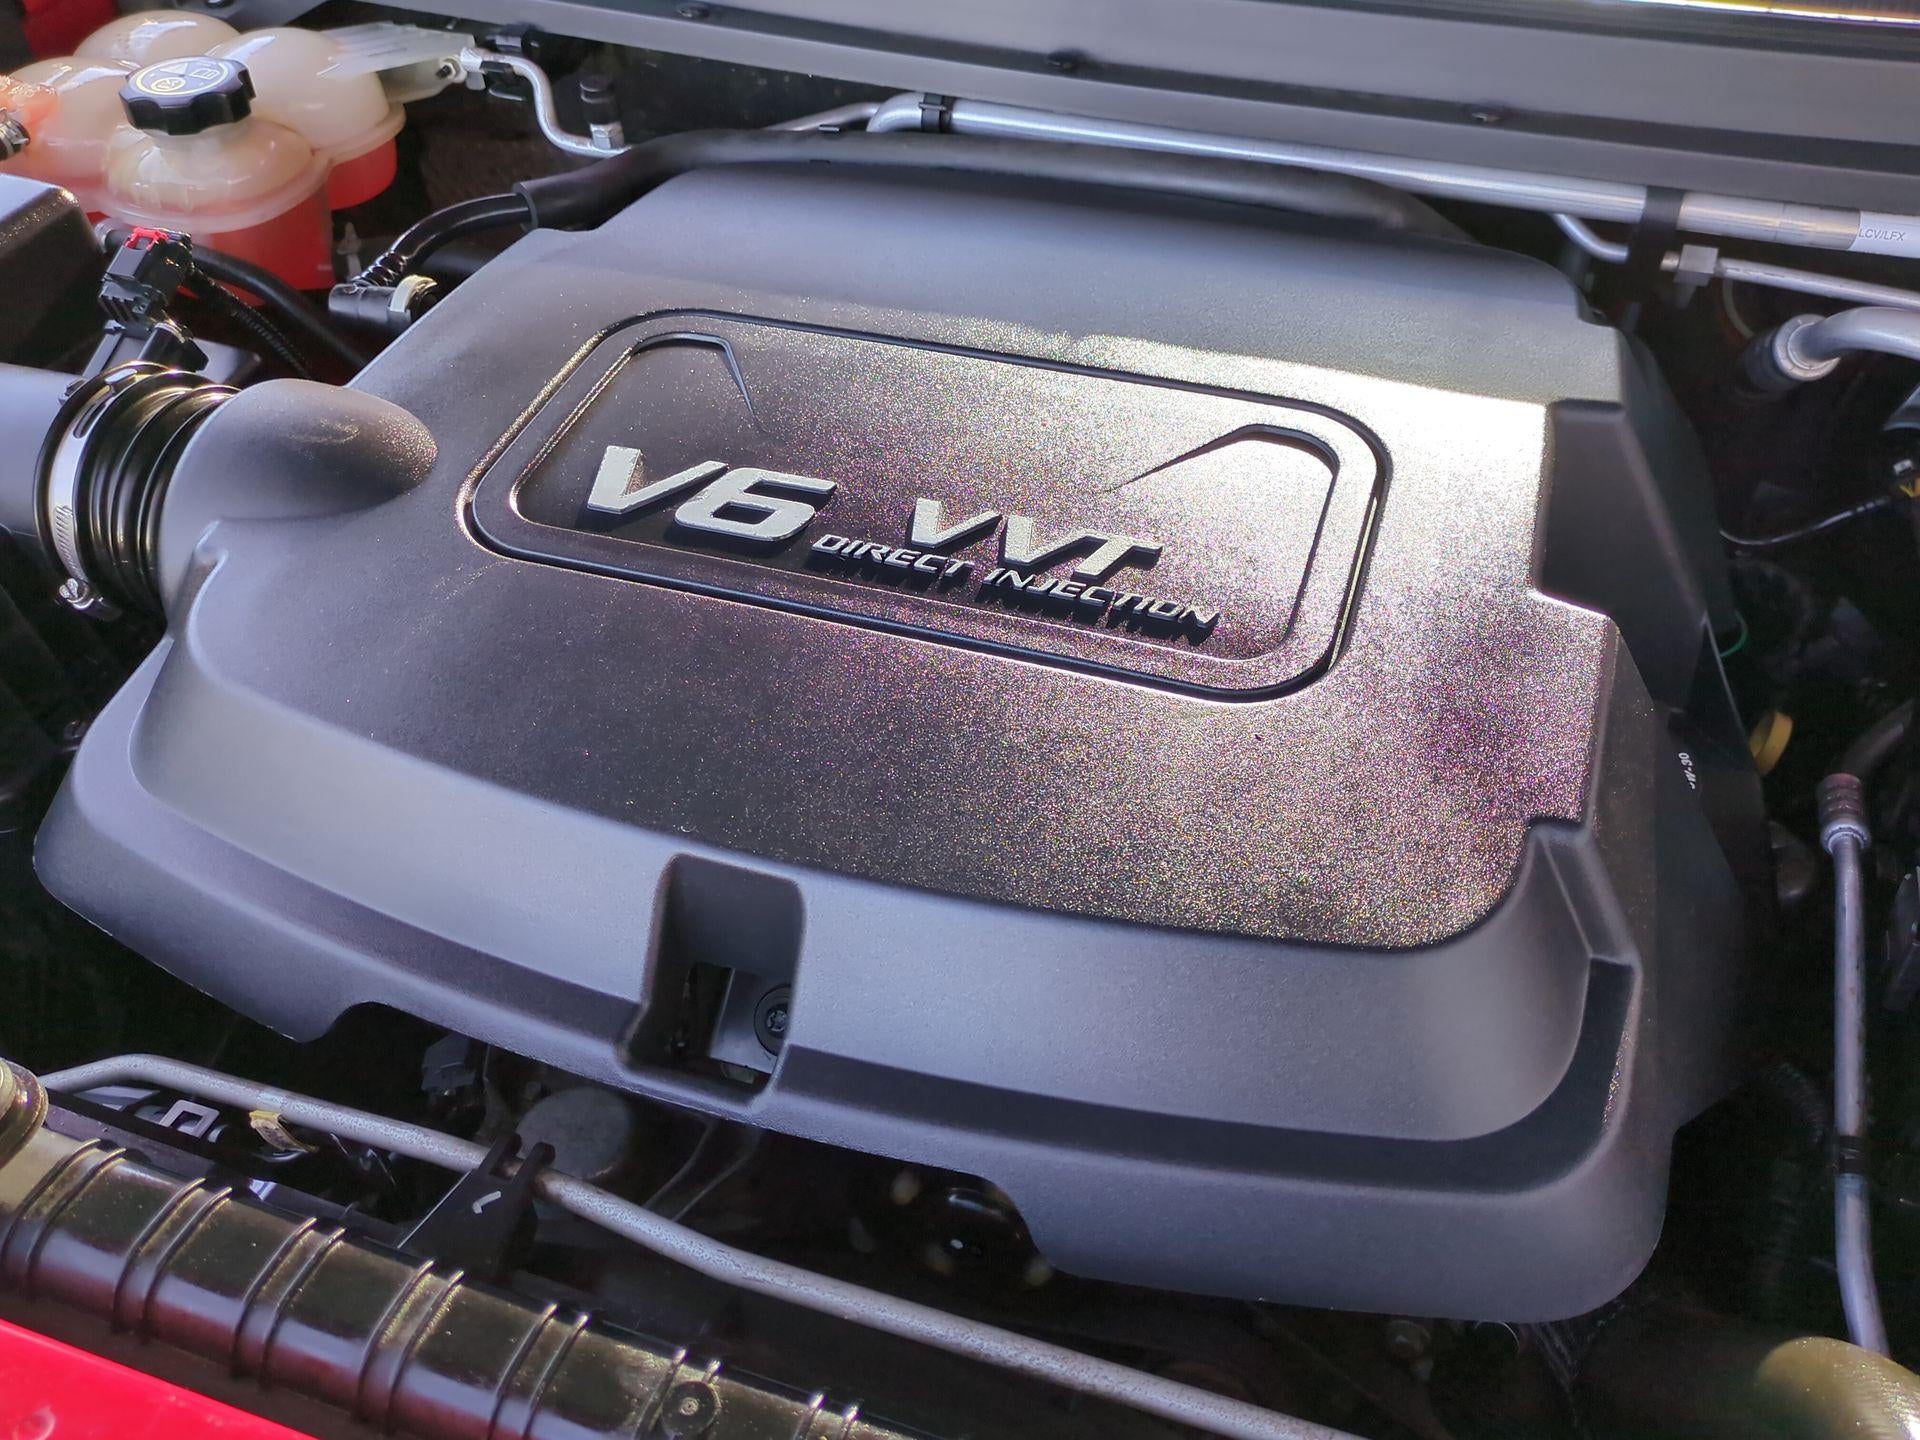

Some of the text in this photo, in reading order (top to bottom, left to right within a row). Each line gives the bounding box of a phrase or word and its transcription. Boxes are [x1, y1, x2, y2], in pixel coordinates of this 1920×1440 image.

[586, 445, 1164, 580] V6 VVT
[811, 533, 1219, 628] DIRECT INJECTION
